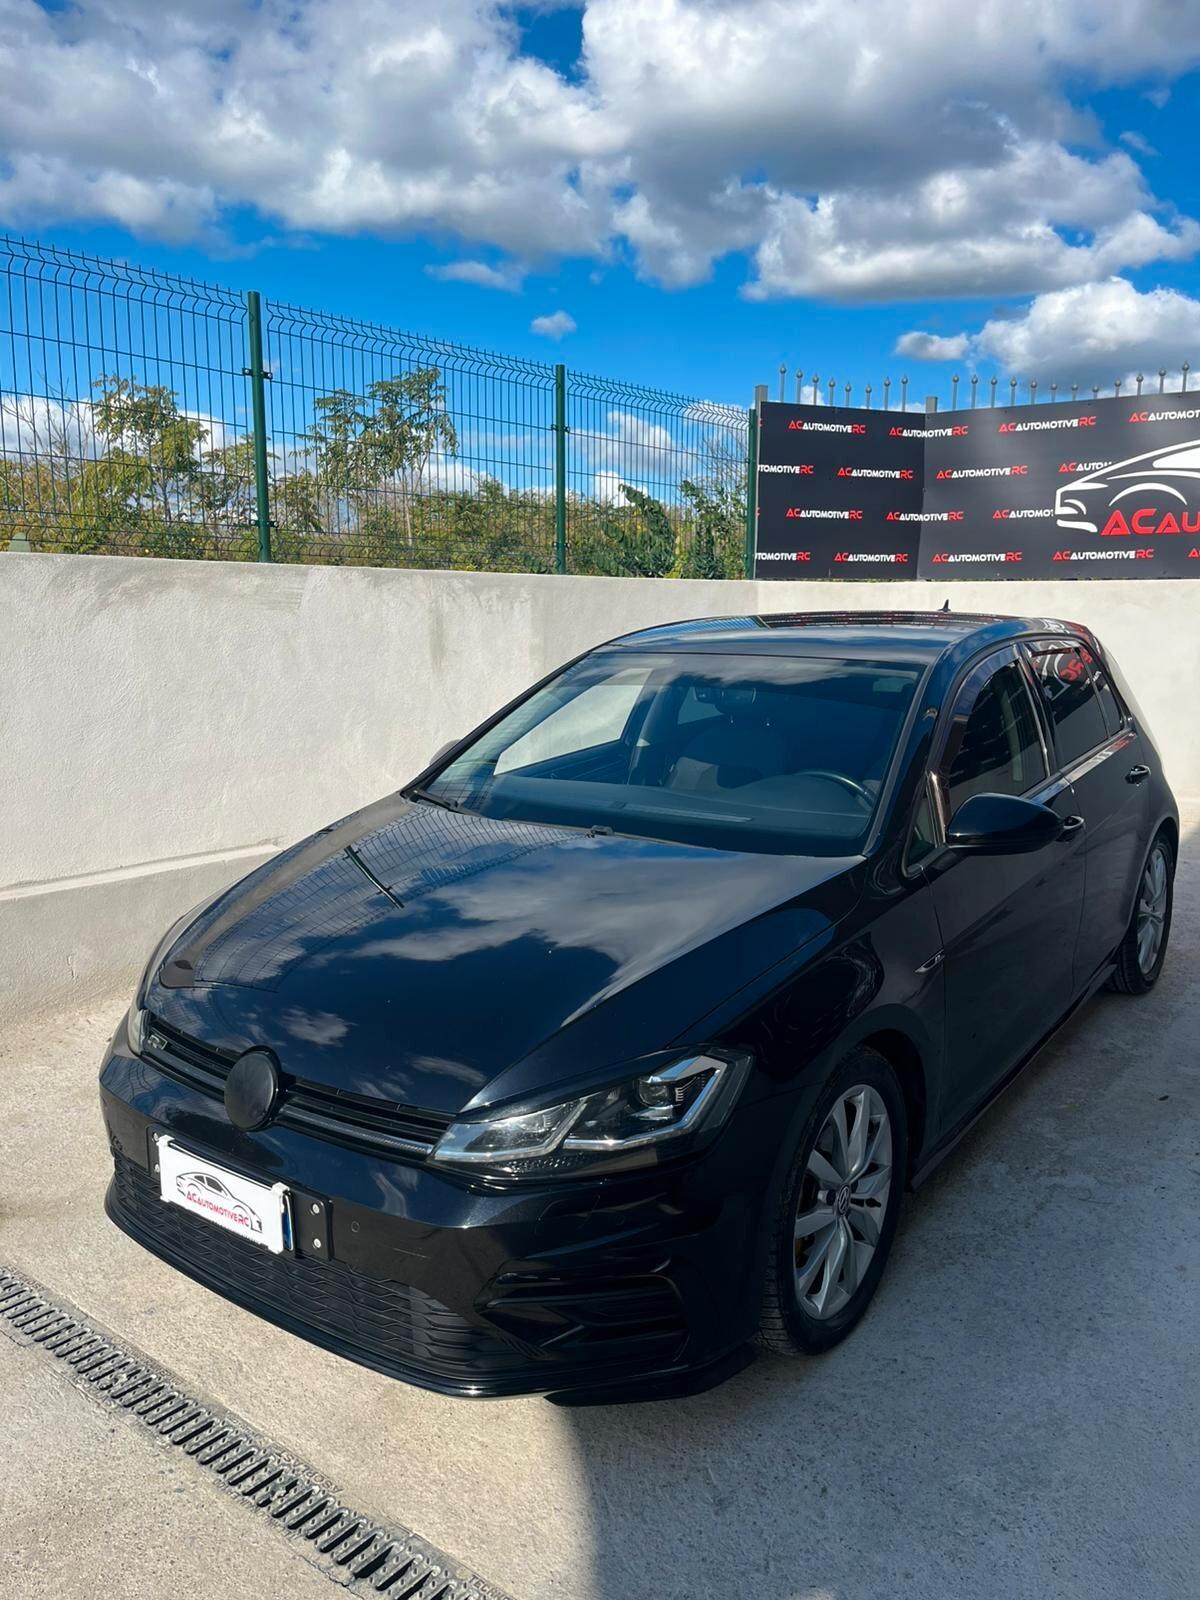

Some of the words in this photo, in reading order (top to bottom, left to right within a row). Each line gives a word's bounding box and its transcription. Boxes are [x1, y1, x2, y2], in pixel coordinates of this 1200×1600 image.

[788, 419, 866, 434] ACAUTOMOTIVERC
[999, 416, 1096, 433] ACAUTOMOTIVERC
[889, 425, 969, 438] ACAUTOMOTIVERC
[837, 467, 914, 480] ACAUTOMOTIVERC
[936, 465, 1028, 480] ACAUTOMOTIVERC
[786, 507, 863, 520] ACAUTOMOTIVERC
[886, 511, 964, 522] ACAUTOMOTIVERC
[834, 552, 908, 563] ACAUTOMOTIVERC
[932, 552, 1023, 563] ACAUTOMOTIVERC
[1052, 549, 1154, 561] ACAUTOMOTIVERC
[186, 1190, 249, 1227] ACAUTOMOTIVERC
